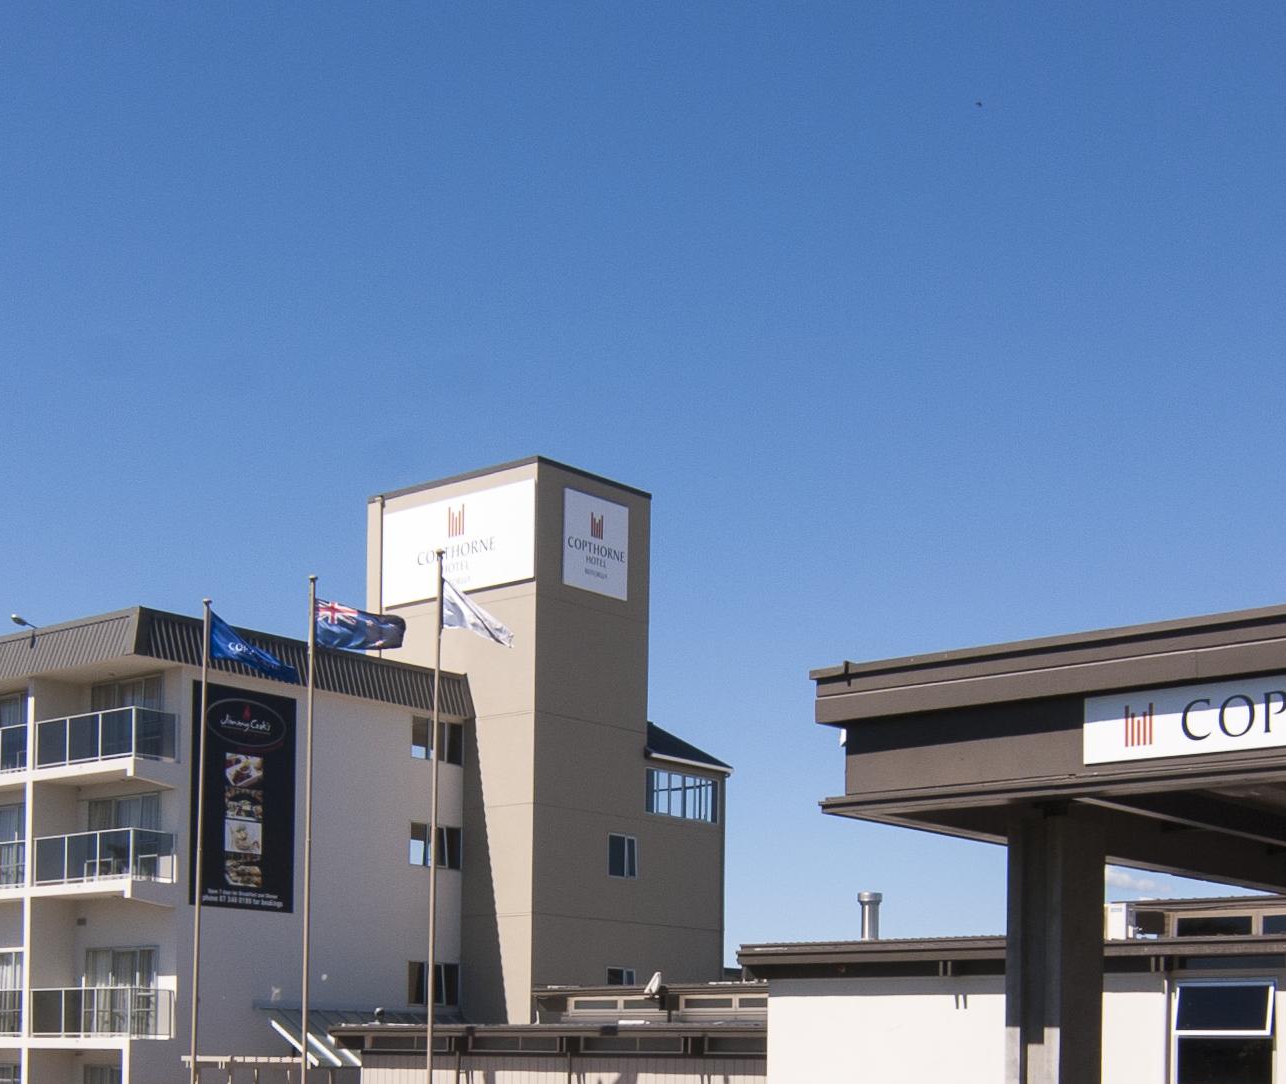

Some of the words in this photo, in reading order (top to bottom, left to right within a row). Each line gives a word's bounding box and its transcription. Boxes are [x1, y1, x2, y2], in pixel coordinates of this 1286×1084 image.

[417, 536, 495, 565] COTHORNE
[567, 535, 626, 563] COPTHORNE
[585, 555, 606, 568] HOTEL
[220, 713, 250, 732] Jimmy
